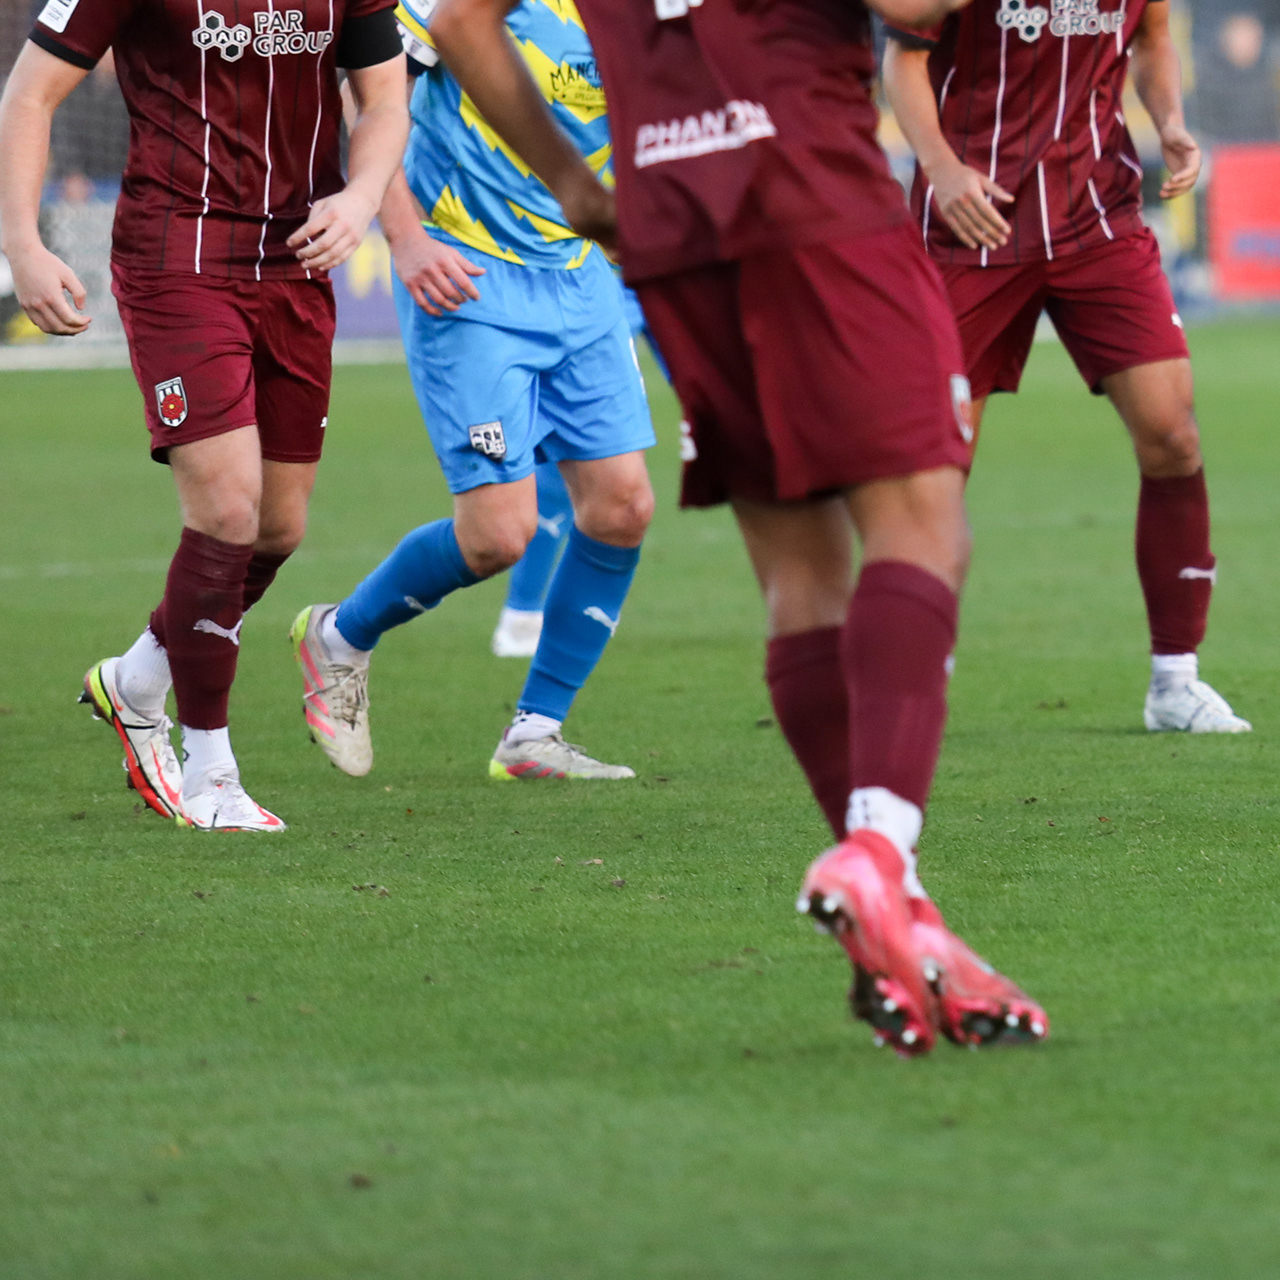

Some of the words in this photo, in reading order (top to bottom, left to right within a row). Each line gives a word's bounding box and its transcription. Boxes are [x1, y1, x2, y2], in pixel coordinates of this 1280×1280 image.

[253, 9, 304, 35] PAR
[199, 30, 247, 44] PAR
[252, 29, 335, 58] GROUP
